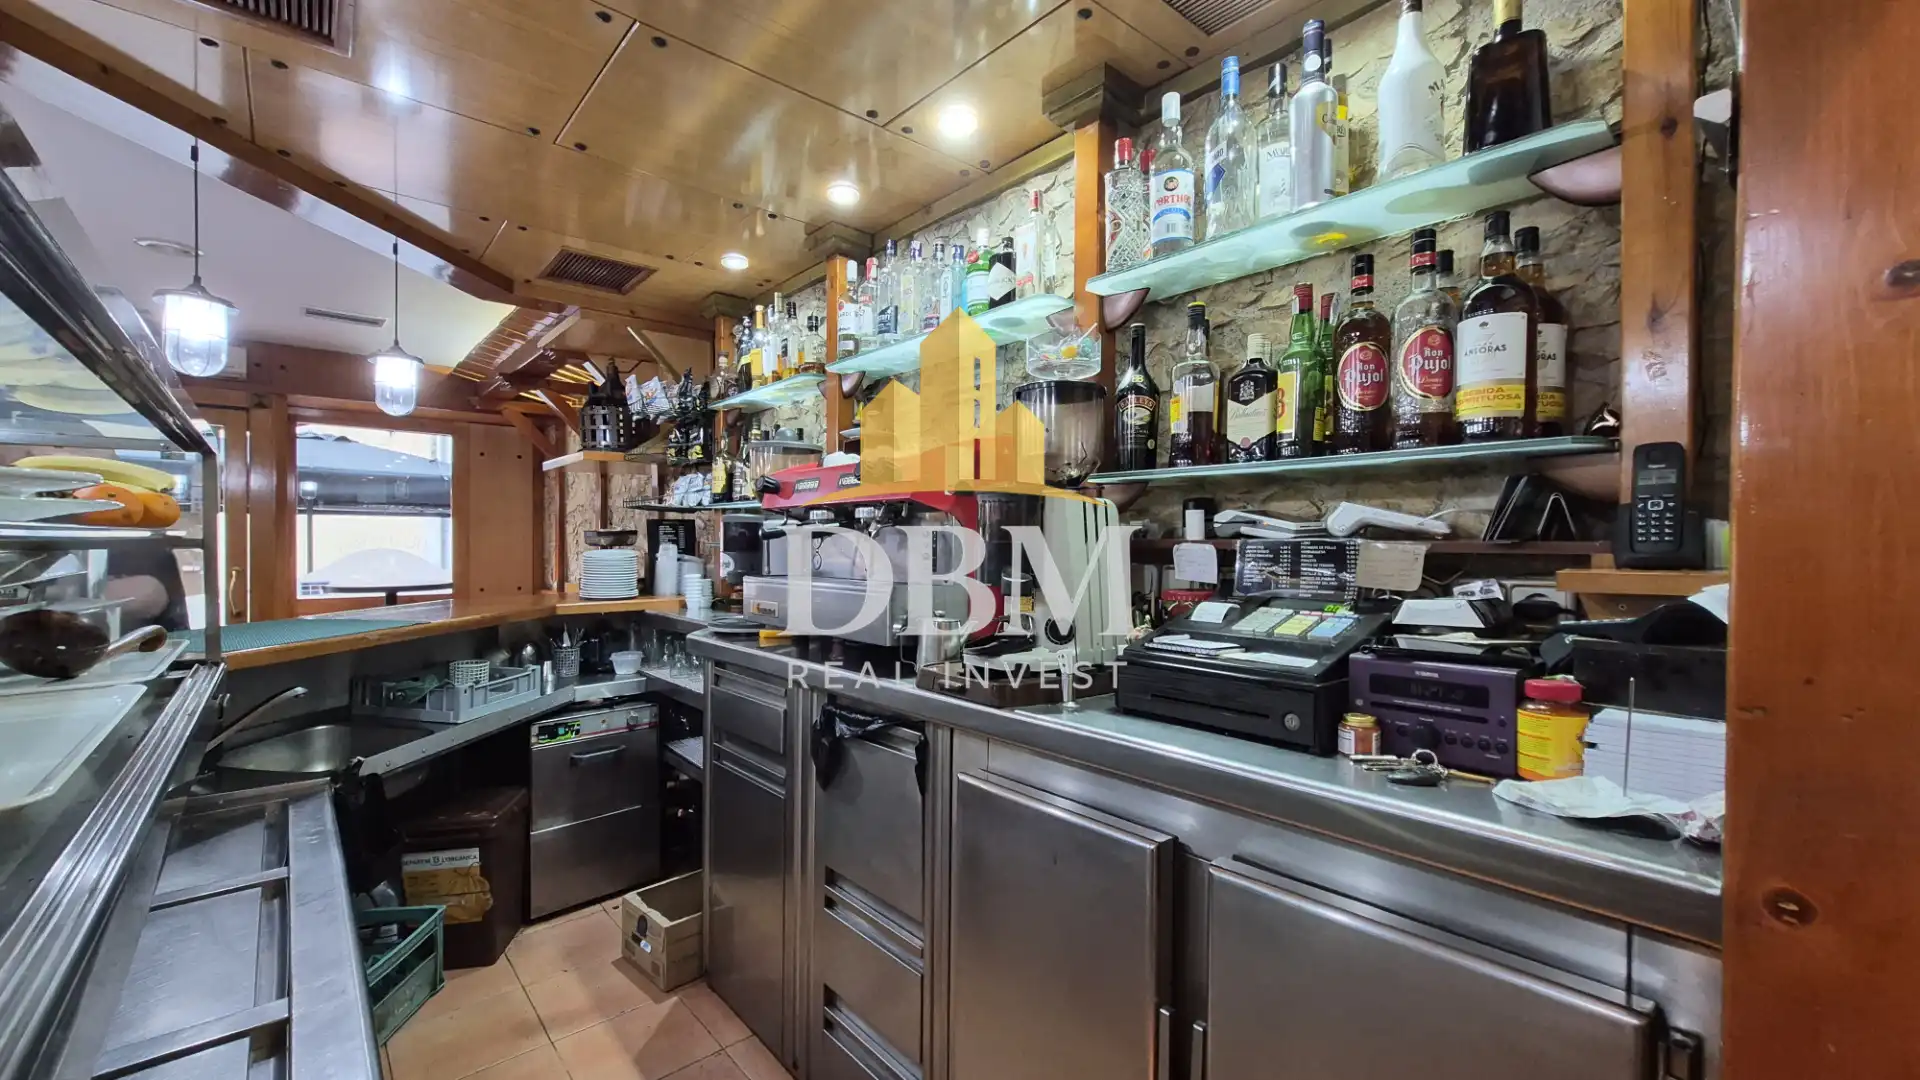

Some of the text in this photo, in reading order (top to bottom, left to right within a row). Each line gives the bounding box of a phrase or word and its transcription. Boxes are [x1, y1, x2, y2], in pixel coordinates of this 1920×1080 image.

[1424, 347, 1444, 357] Ron
[1409, 354, 1452, 375] Pujol
[1344, 368, 1384, 388] Pujol
